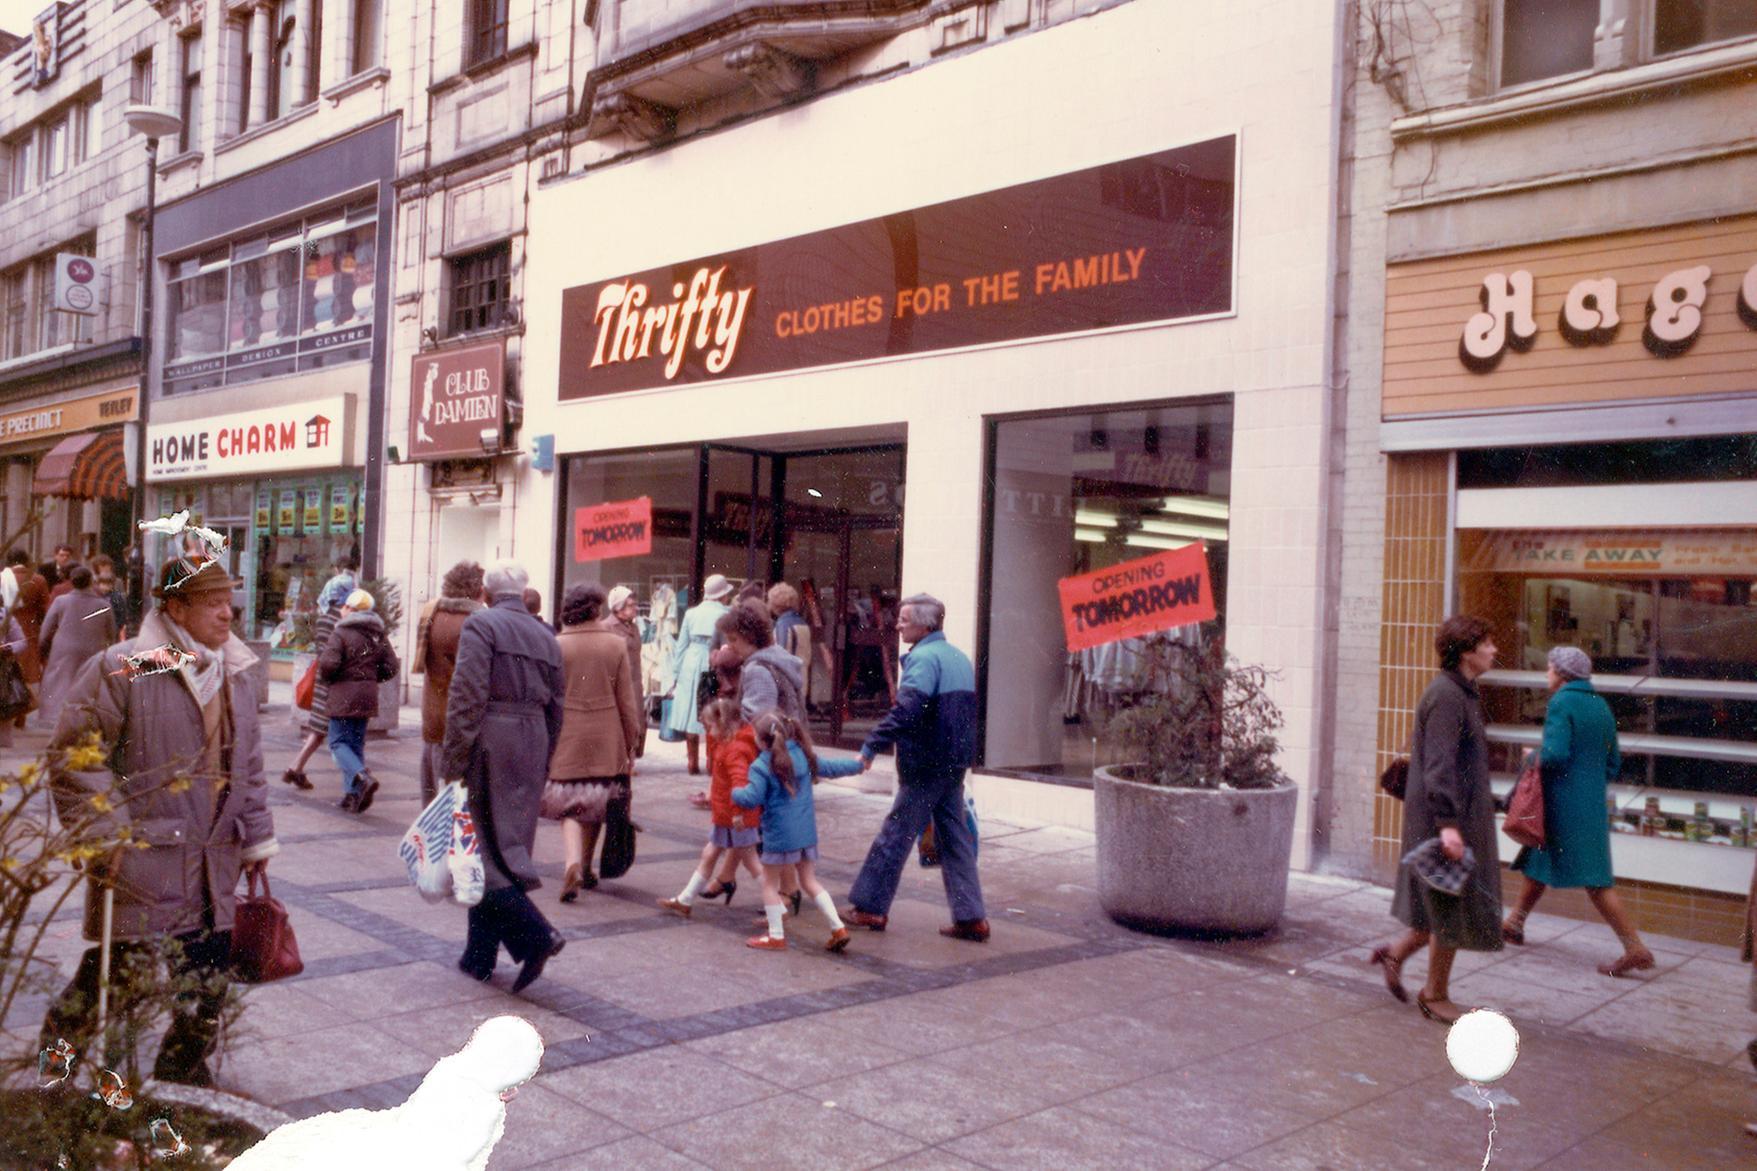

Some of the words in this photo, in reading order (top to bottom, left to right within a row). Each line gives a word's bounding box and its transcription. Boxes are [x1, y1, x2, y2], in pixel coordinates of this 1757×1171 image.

[775, 295, 882, 338] CLOTHES
[896, 283, 951, 318] FOR
[963, 271, 1020, 307] THE
[1035, 247, 1146, 294] FAMILY
[588, 265, 753, 380] Thrifty
[168, 361, 222, 377] WALLPAPER
[241, 349, 281, 362] DESIGN
[315, 330, 365, 347] CENTRE
[445, 368, 490, 396] CLUB
[435, 394, 498, 425] DAMIEN
[153, 432, 208, 464] HOME
[217, 421, 296, 458] CHARM
[582, 520, 646, 549] TOMORROW
[1514, 548, 1576, 561] TAKE
[1585, 548, 1664, 561] AWAY
[1092, 561, 1165, 594] OPENING
[1072, 573, 1201, 633] TOMORROW
